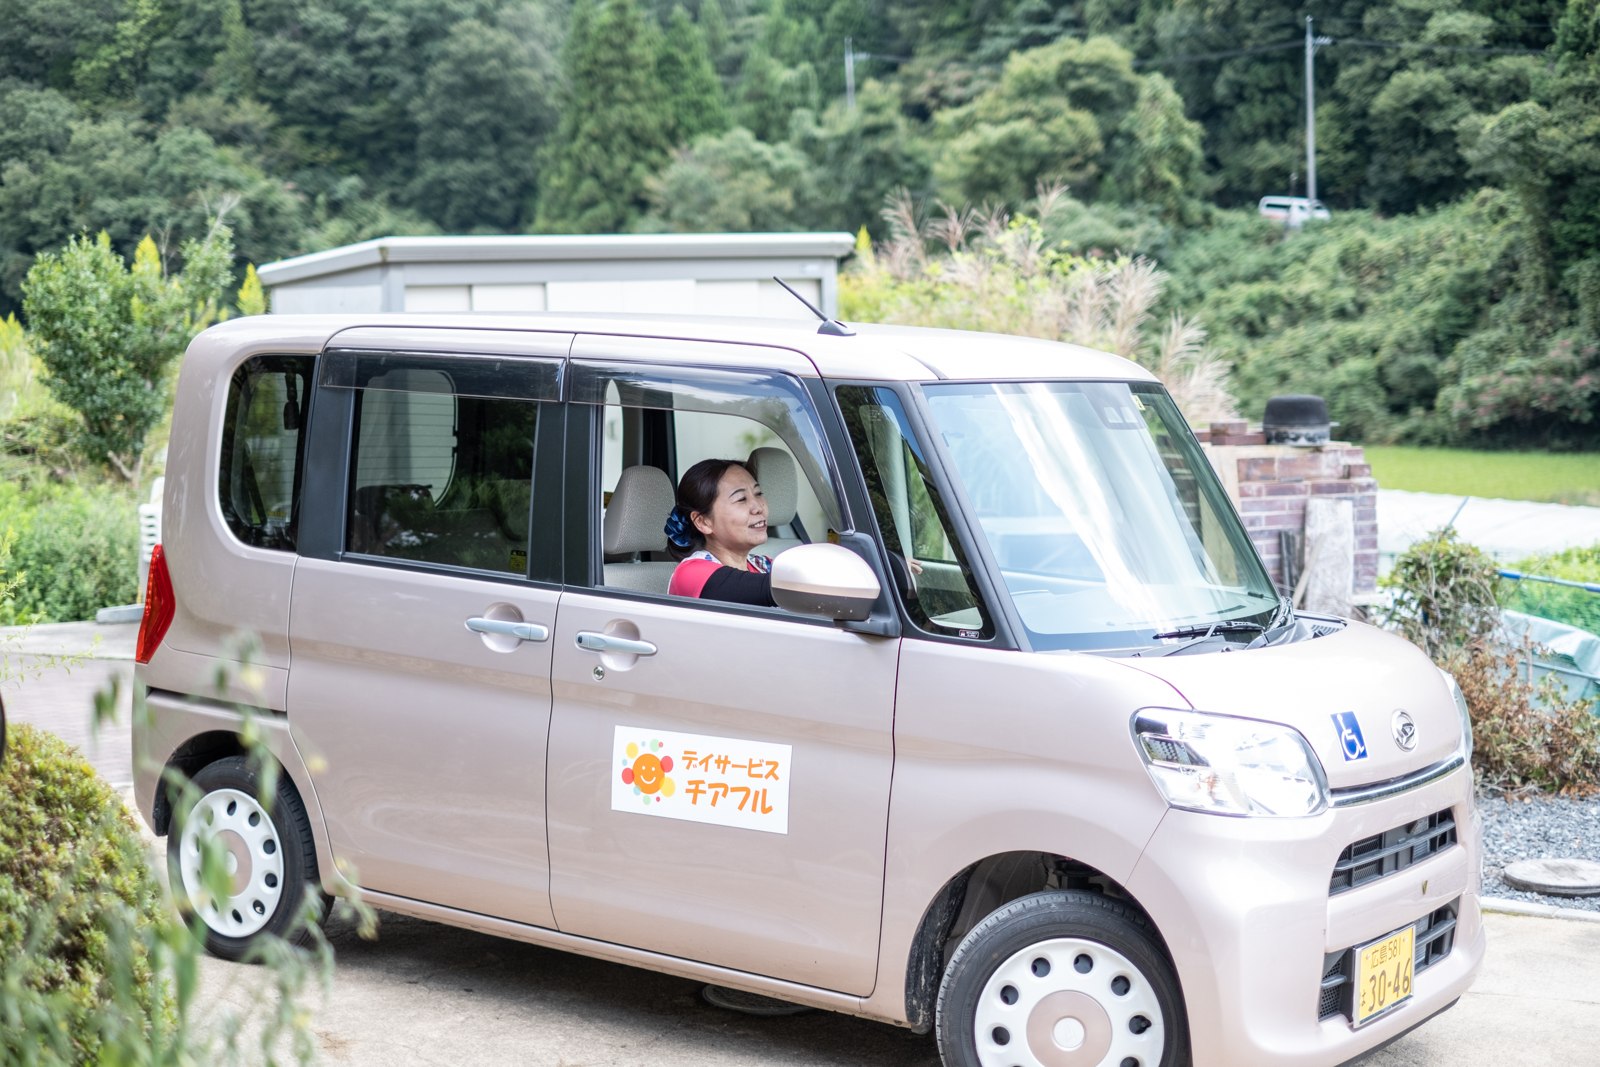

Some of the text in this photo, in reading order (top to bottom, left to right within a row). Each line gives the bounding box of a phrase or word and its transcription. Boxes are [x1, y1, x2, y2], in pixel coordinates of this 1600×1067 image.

[682, 750, 780, 781] デイサービス
[685, 779, 773, 815] チアフル
[1368, 958, 1411, 1012] 30-46
